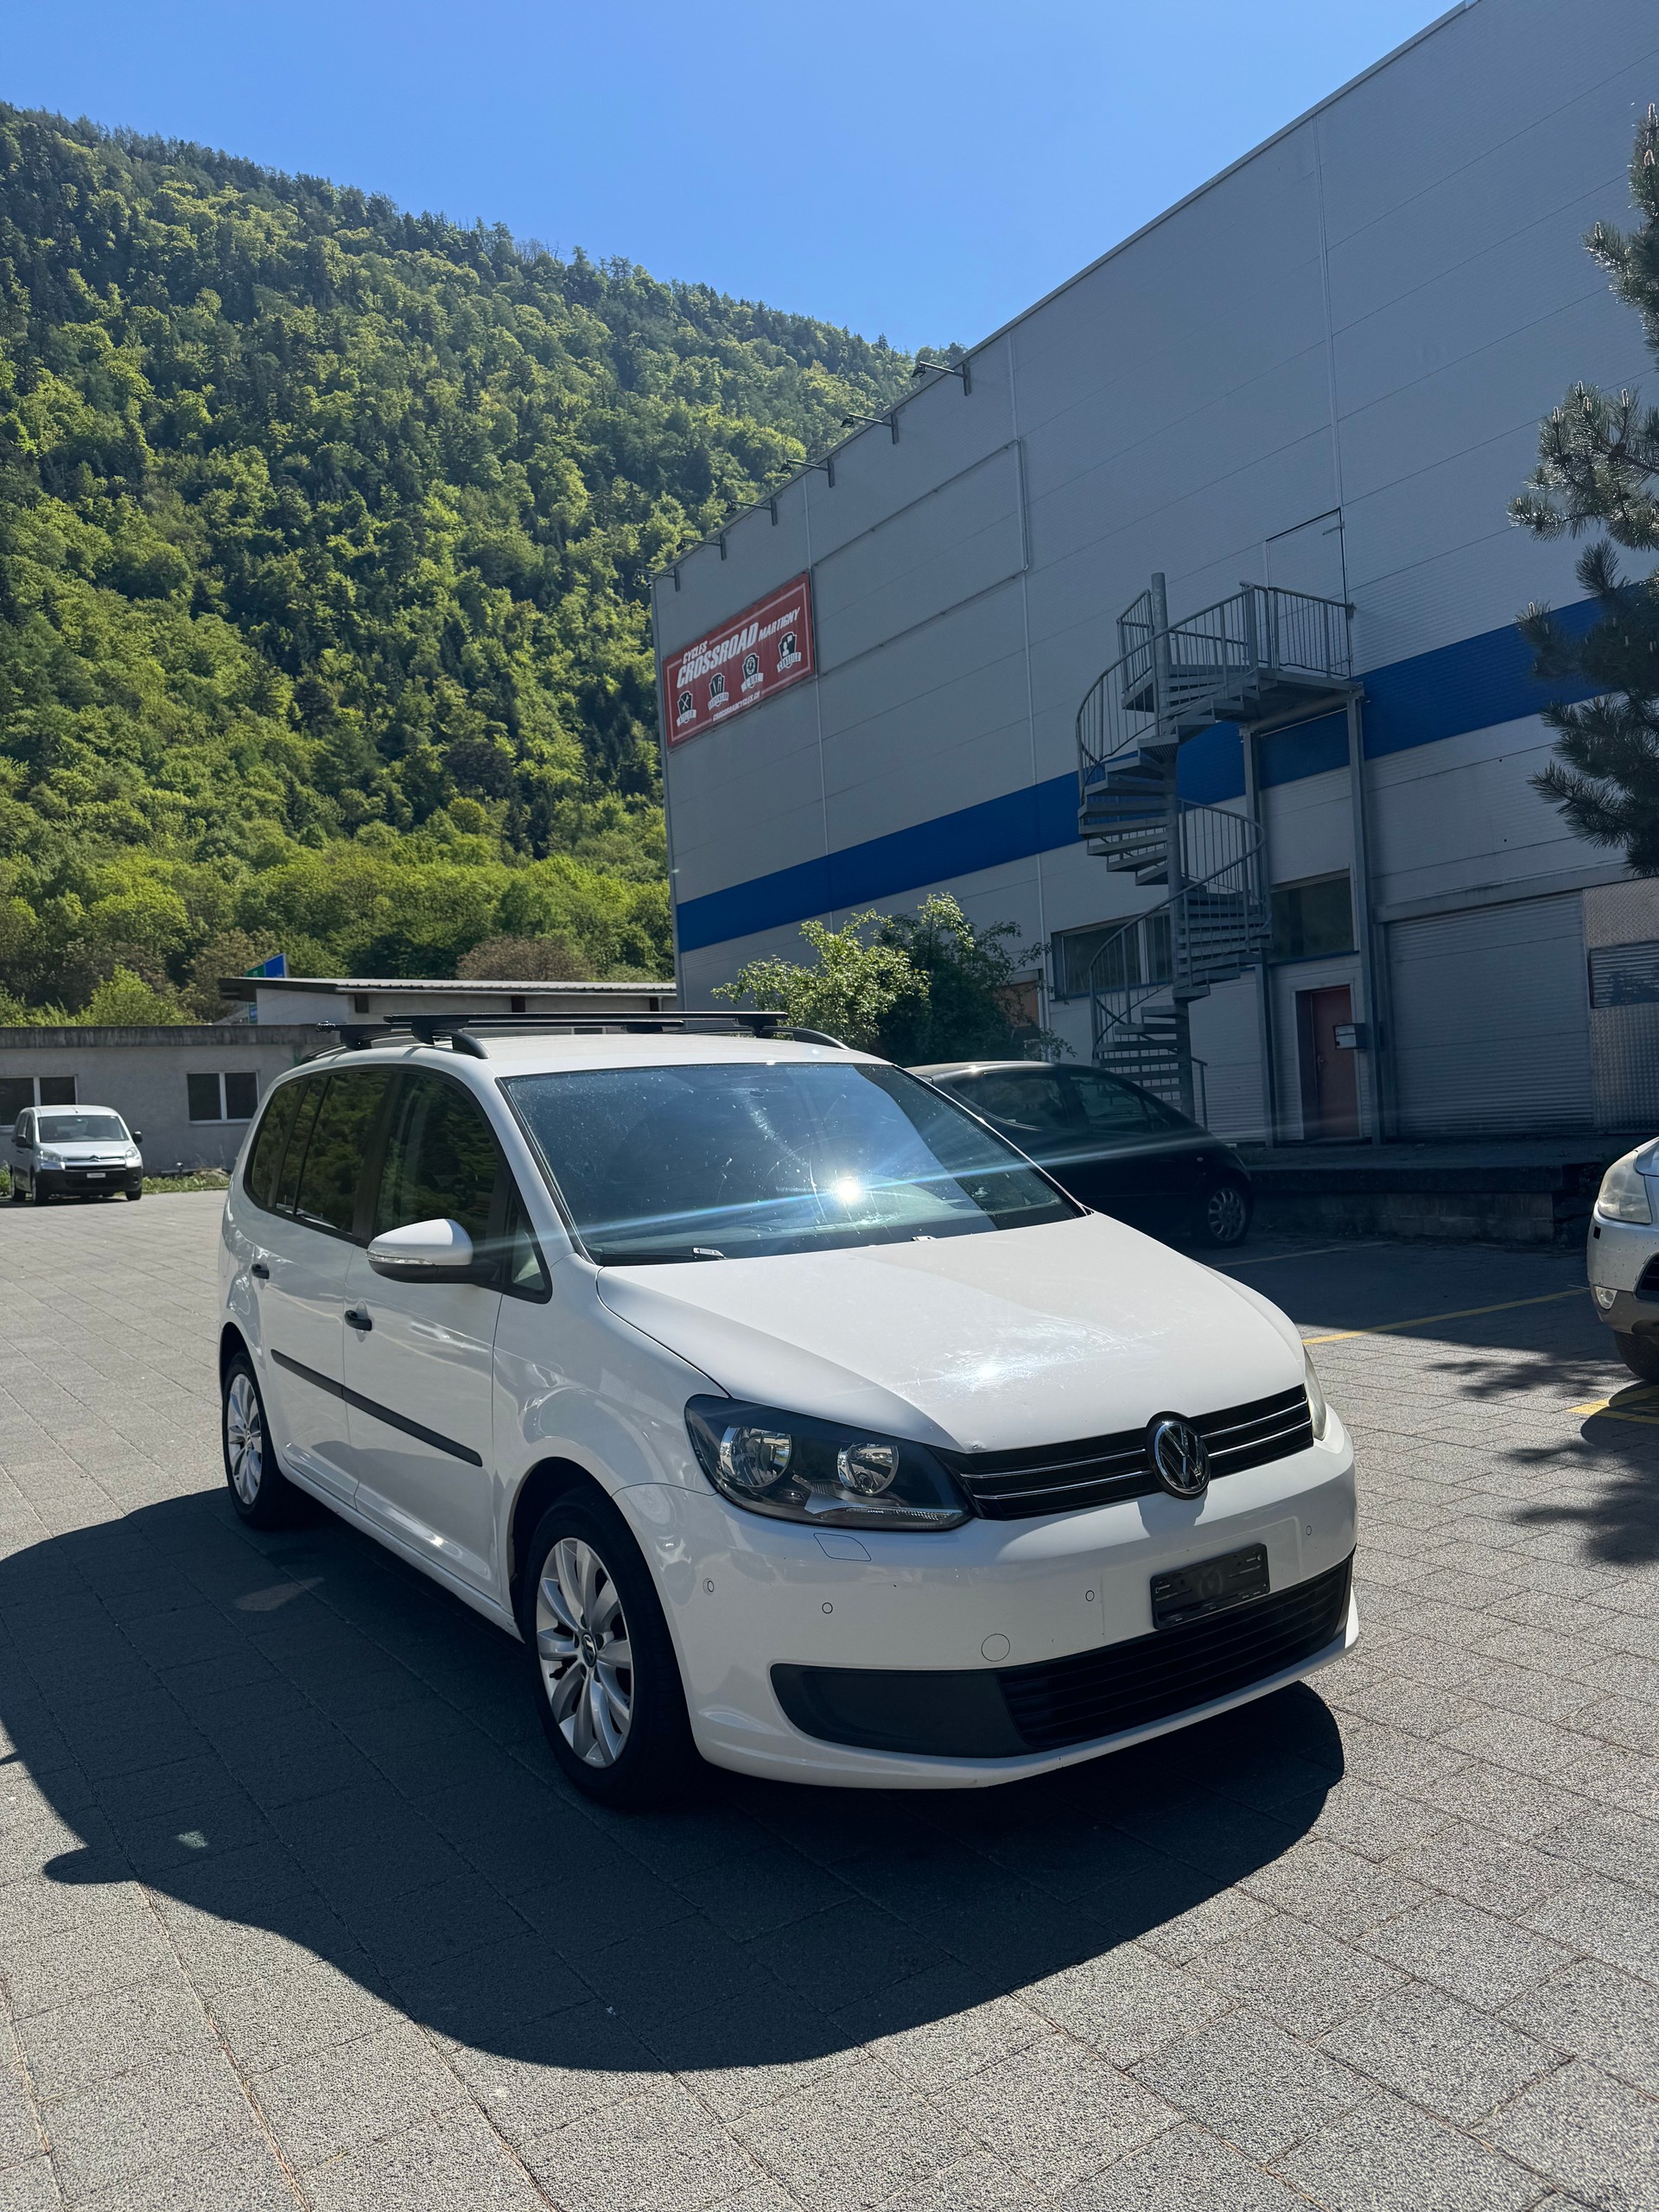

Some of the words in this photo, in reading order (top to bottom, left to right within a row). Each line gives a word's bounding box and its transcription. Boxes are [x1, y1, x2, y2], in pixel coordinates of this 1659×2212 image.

[677, 621, 759, 689] CROSSROAD
[758, 607, 801, 642] MARTIGNY
[683, 640, 708, 664] CYCLES
